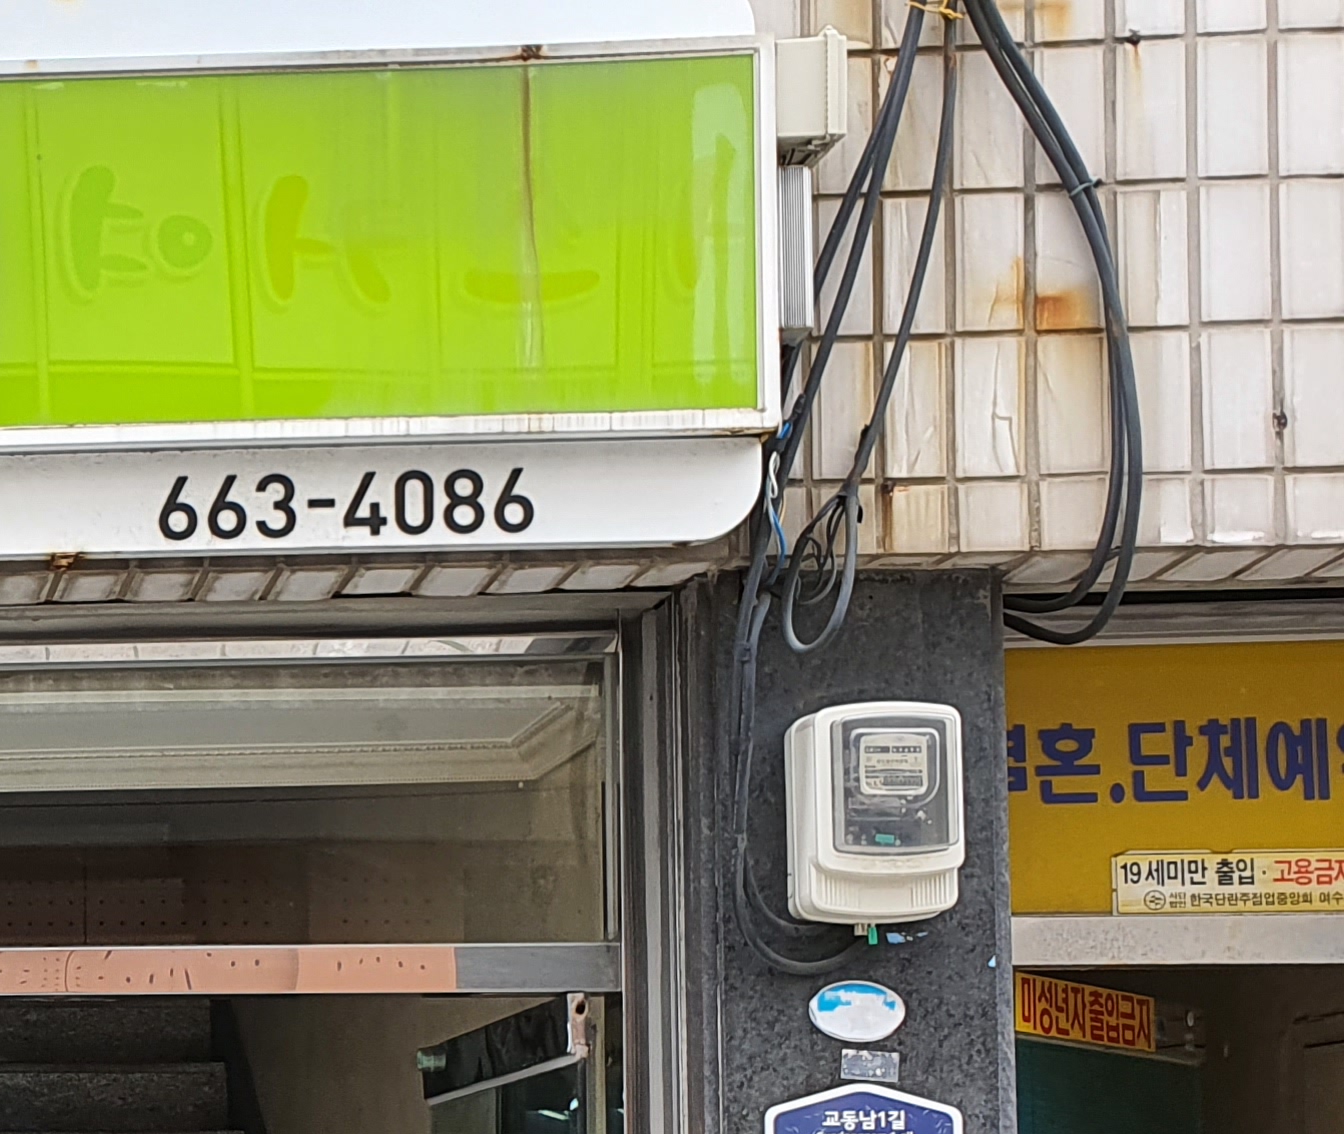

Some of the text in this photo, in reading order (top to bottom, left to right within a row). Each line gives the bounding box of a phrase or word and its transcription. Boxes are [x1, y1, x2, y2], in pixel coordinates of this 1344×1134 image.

[158, 467, 535, 541] 663-4086
[1006, 717, 1344, 804] 혼.단체예
[1215, 857, 1255, 886] 출입
[821, 1110, 906, 1130] 교동남1길
